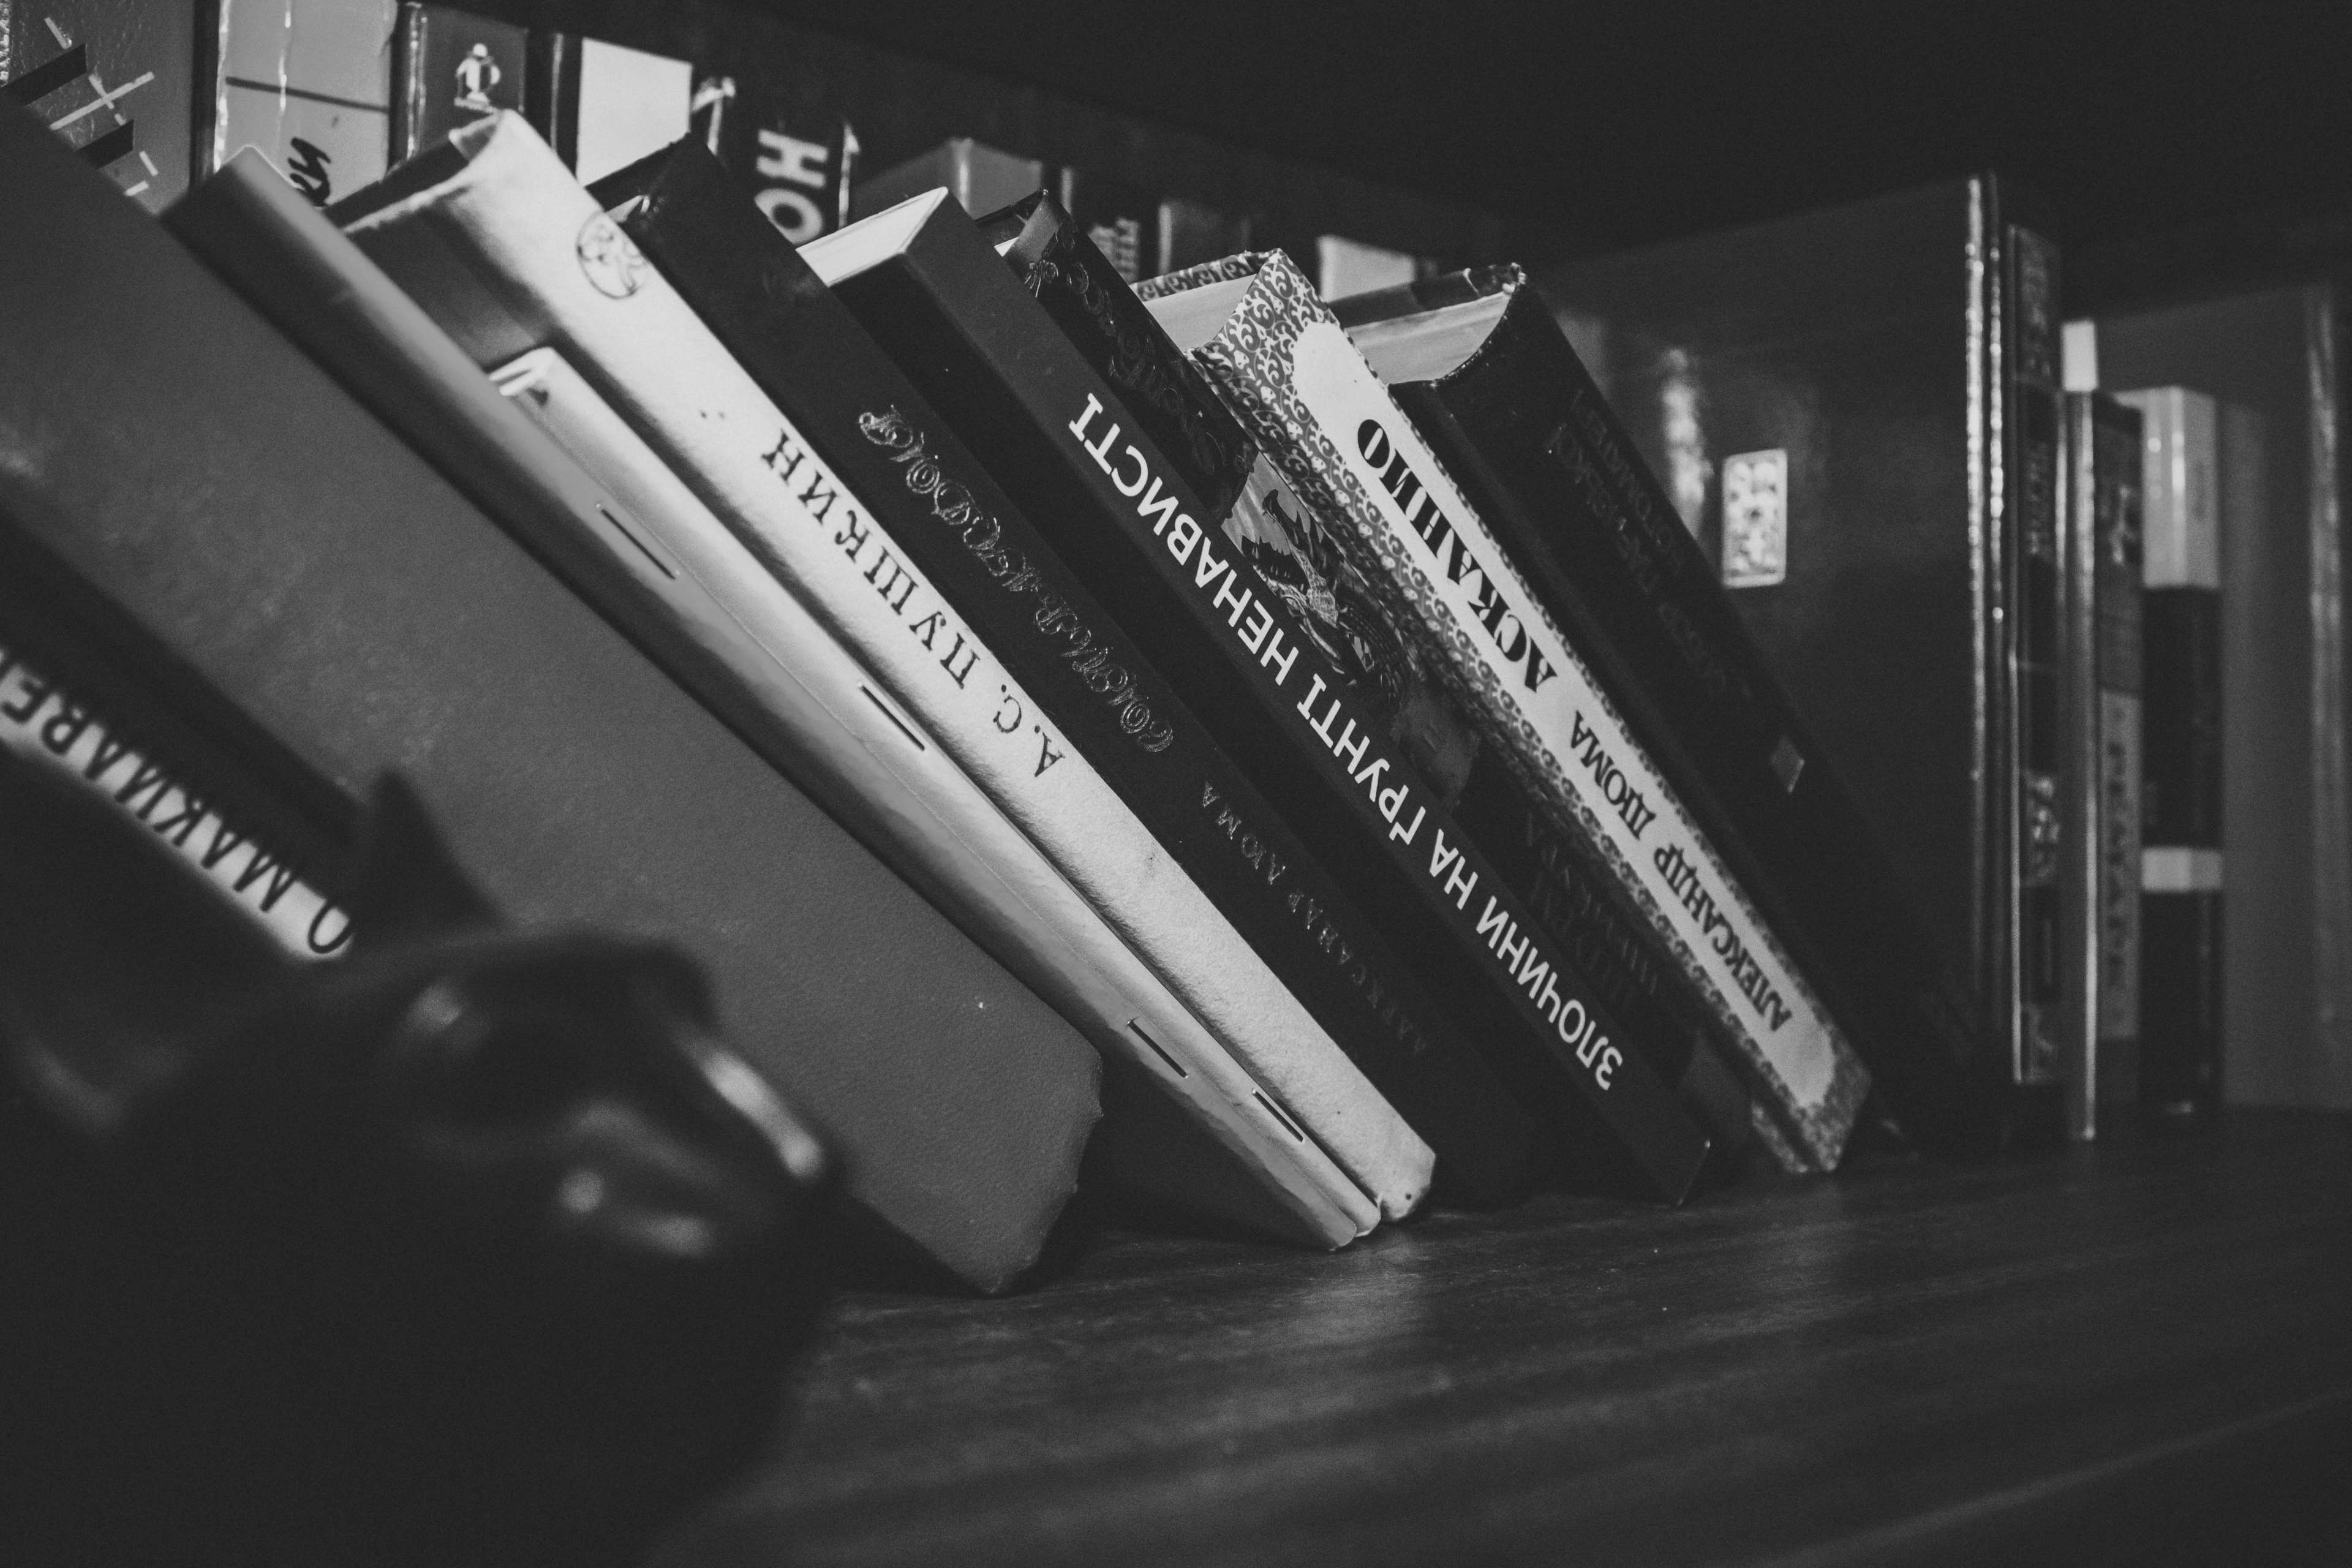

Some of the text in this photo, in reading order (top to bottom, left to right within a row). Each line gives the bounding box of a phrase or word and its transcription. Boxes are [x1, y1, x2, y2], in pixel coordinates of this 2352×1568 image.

[760, 428, 981, 690] ПУШКИН
[0, 665, 293, 913] МАКИАВЕ
[1068, 392, 1623, 1091] ЗЛОЧИНИ НА ҐРУНТІ НЕНАВИСТІ
[1200, 779, 1287, 888] ДЮМА
[1357, 418, 1793, 1032] АЛЕКСАНДР ДЮМА АСКАНИО
